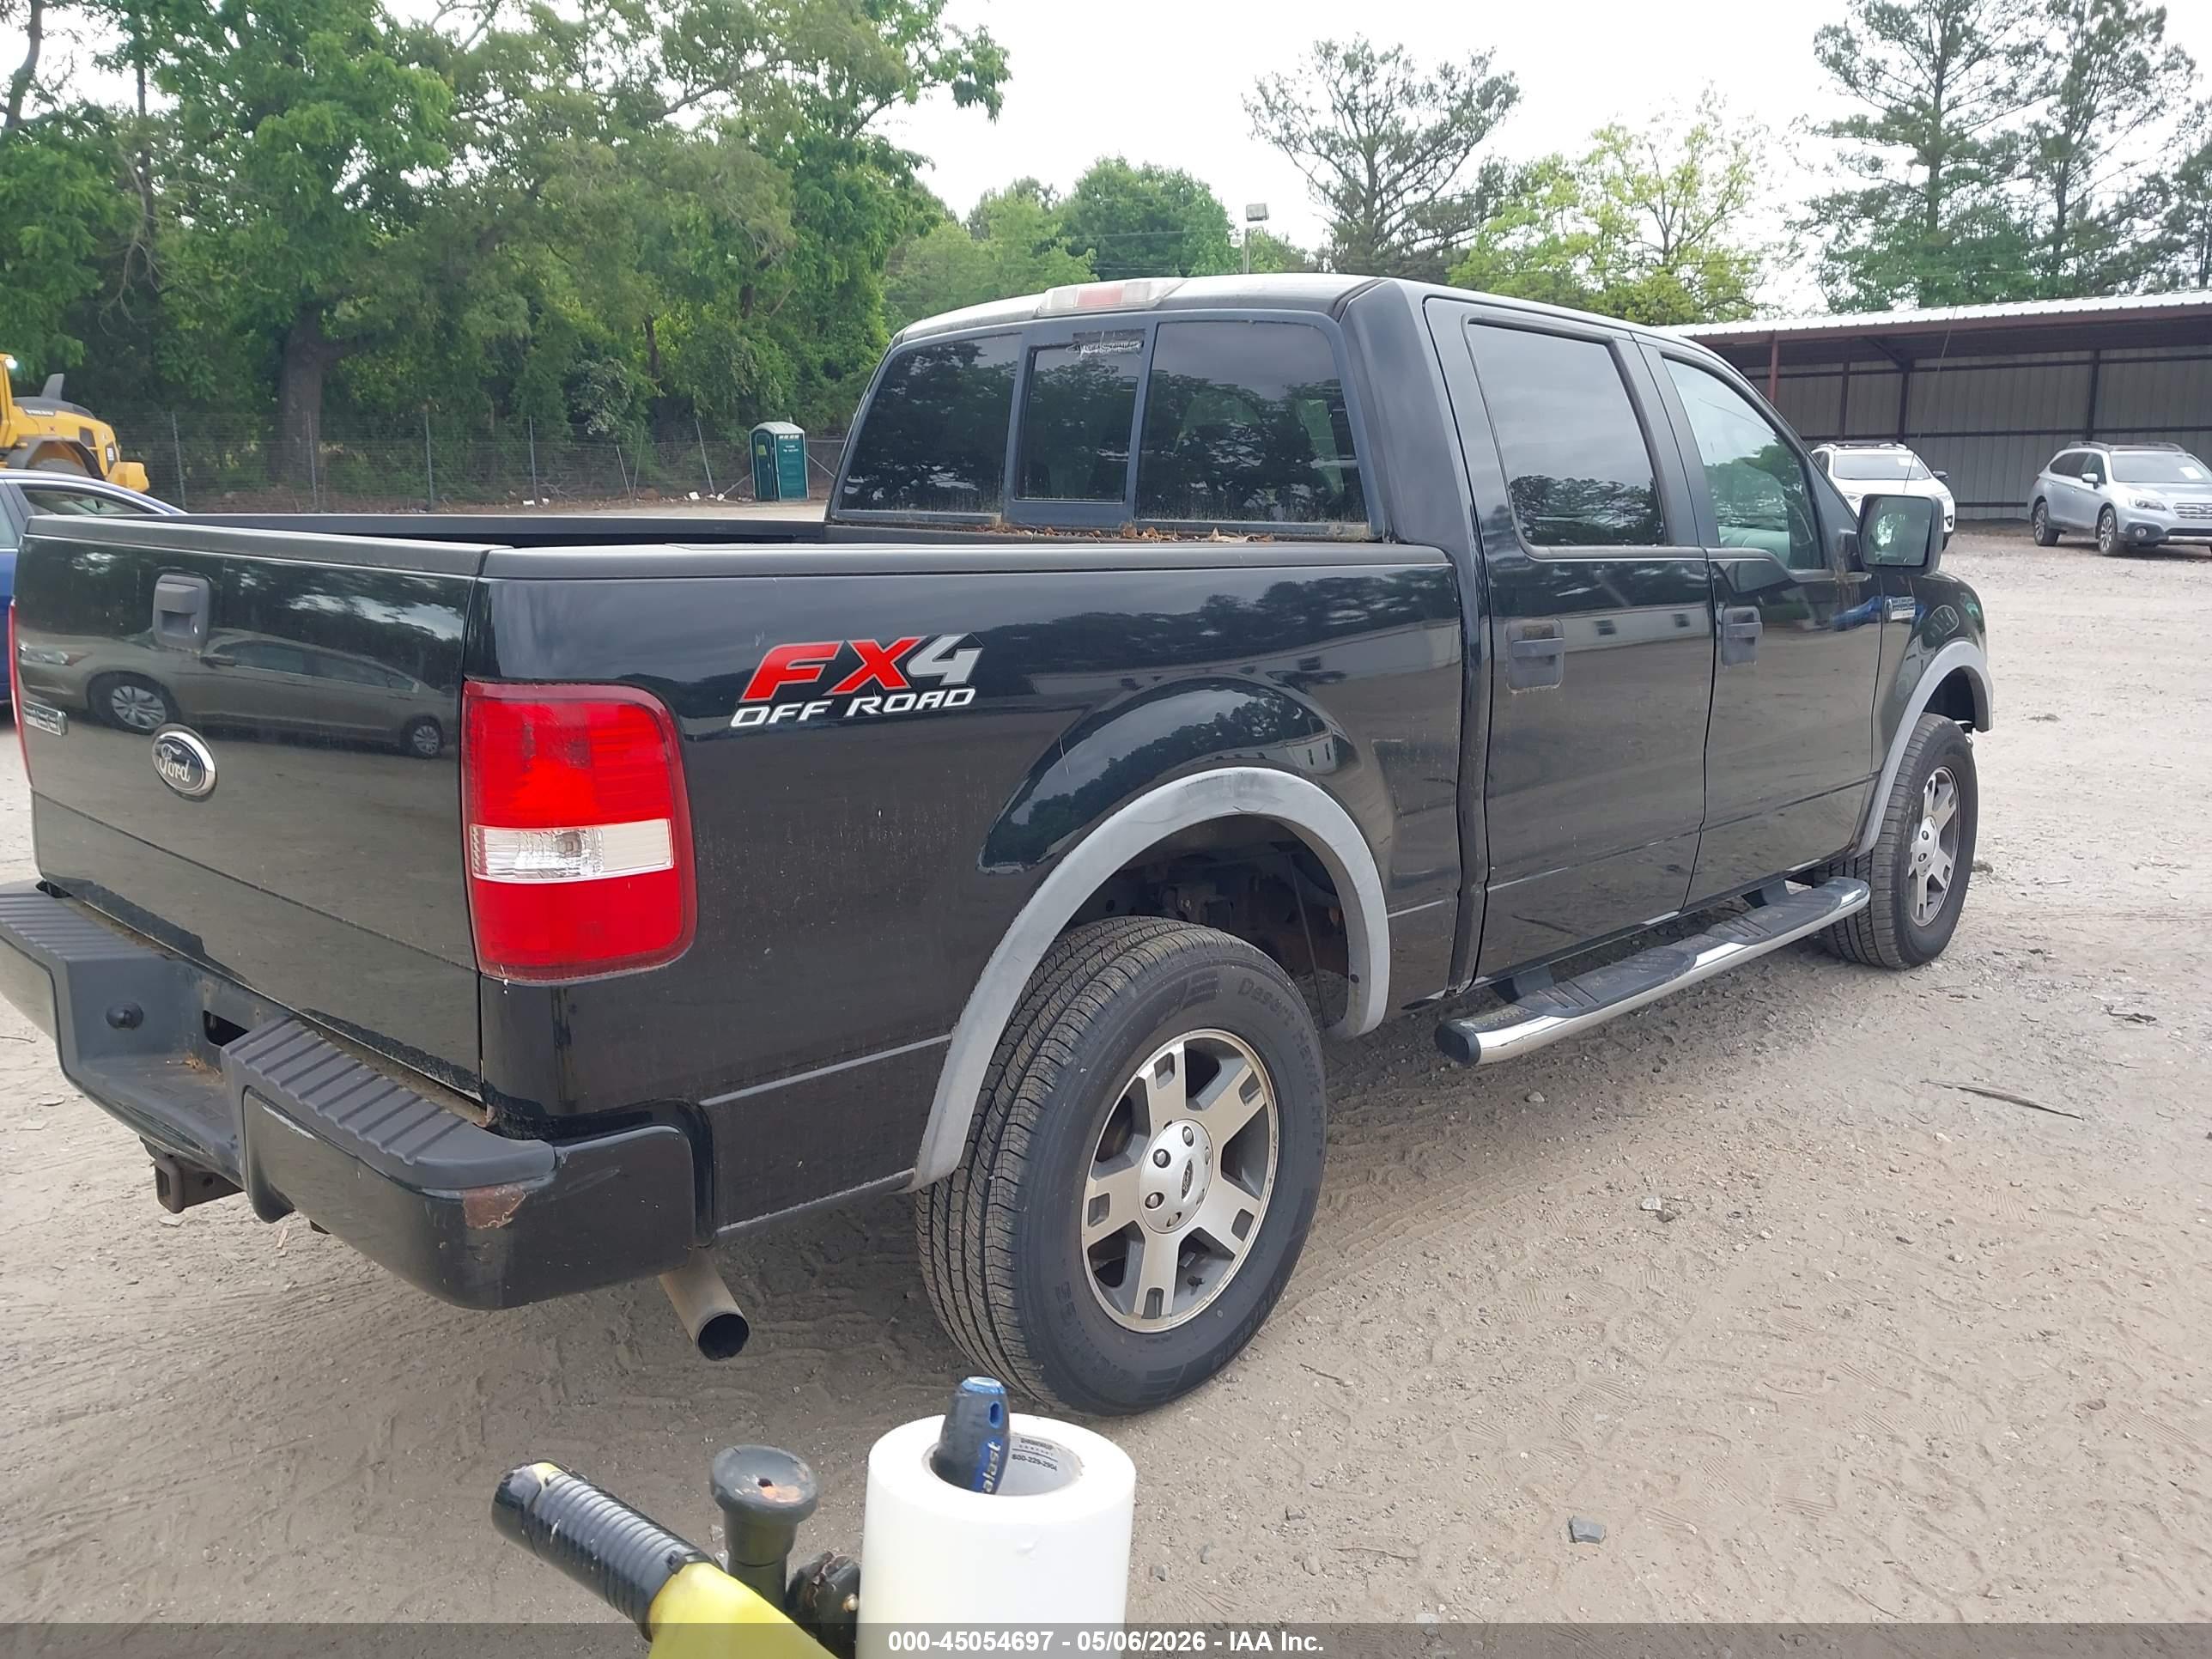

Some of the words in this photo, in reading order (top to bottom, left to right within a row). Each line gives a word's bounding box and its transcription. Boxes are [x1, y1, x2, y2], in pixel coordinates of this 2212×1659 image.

[738, 632, 984, 702] FX4
[731, 699, 834, 727] OFF
[843, 687, 976, 718] ROAD
[158, 743, 191, 783] Ford
[981, 1441, 1001, 1493] alast
